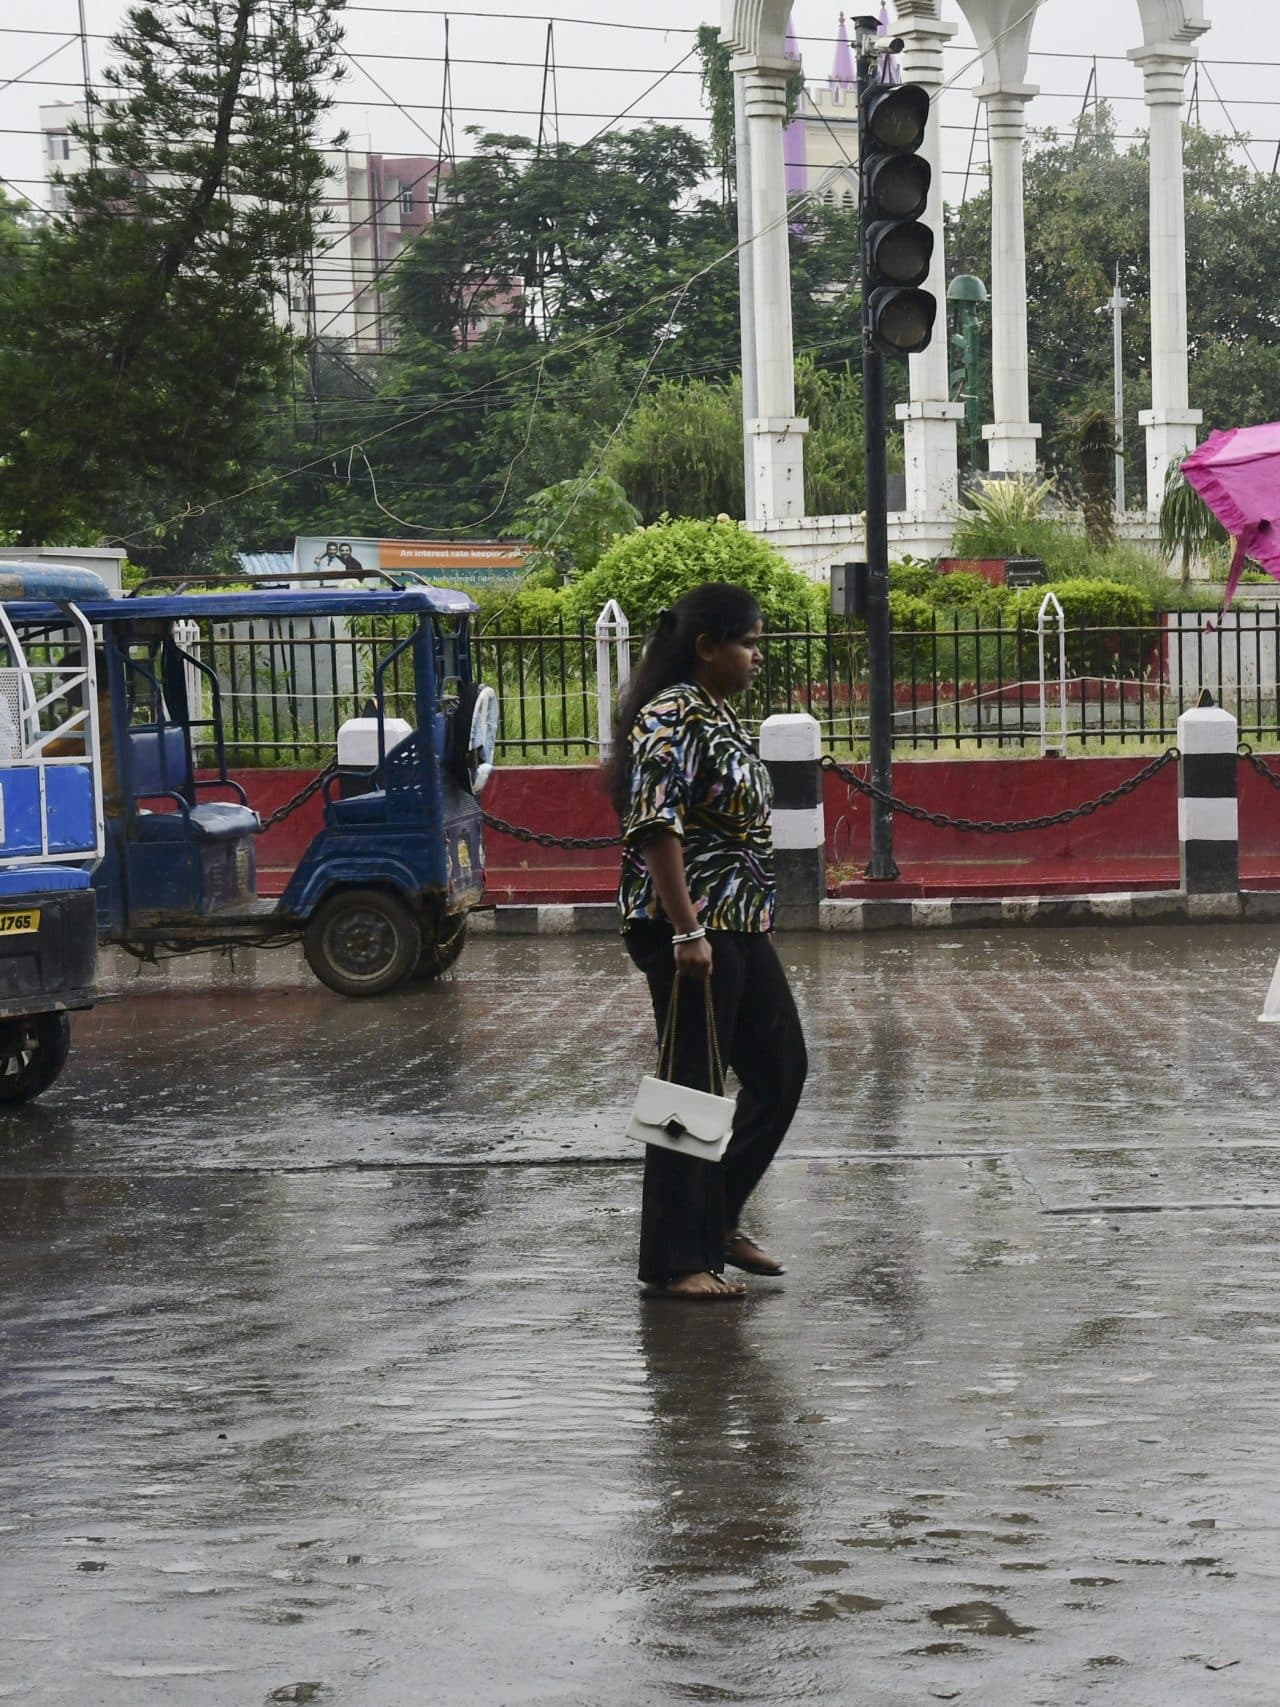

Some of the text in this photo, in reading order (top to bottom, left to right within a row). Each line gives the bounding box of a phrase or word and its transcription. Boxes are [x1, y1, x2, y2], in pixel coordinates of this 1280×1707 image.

[400, 549, 413, 558] An
[415, 549, 449, 558] interest
[451, 550, 469, 558] rate
